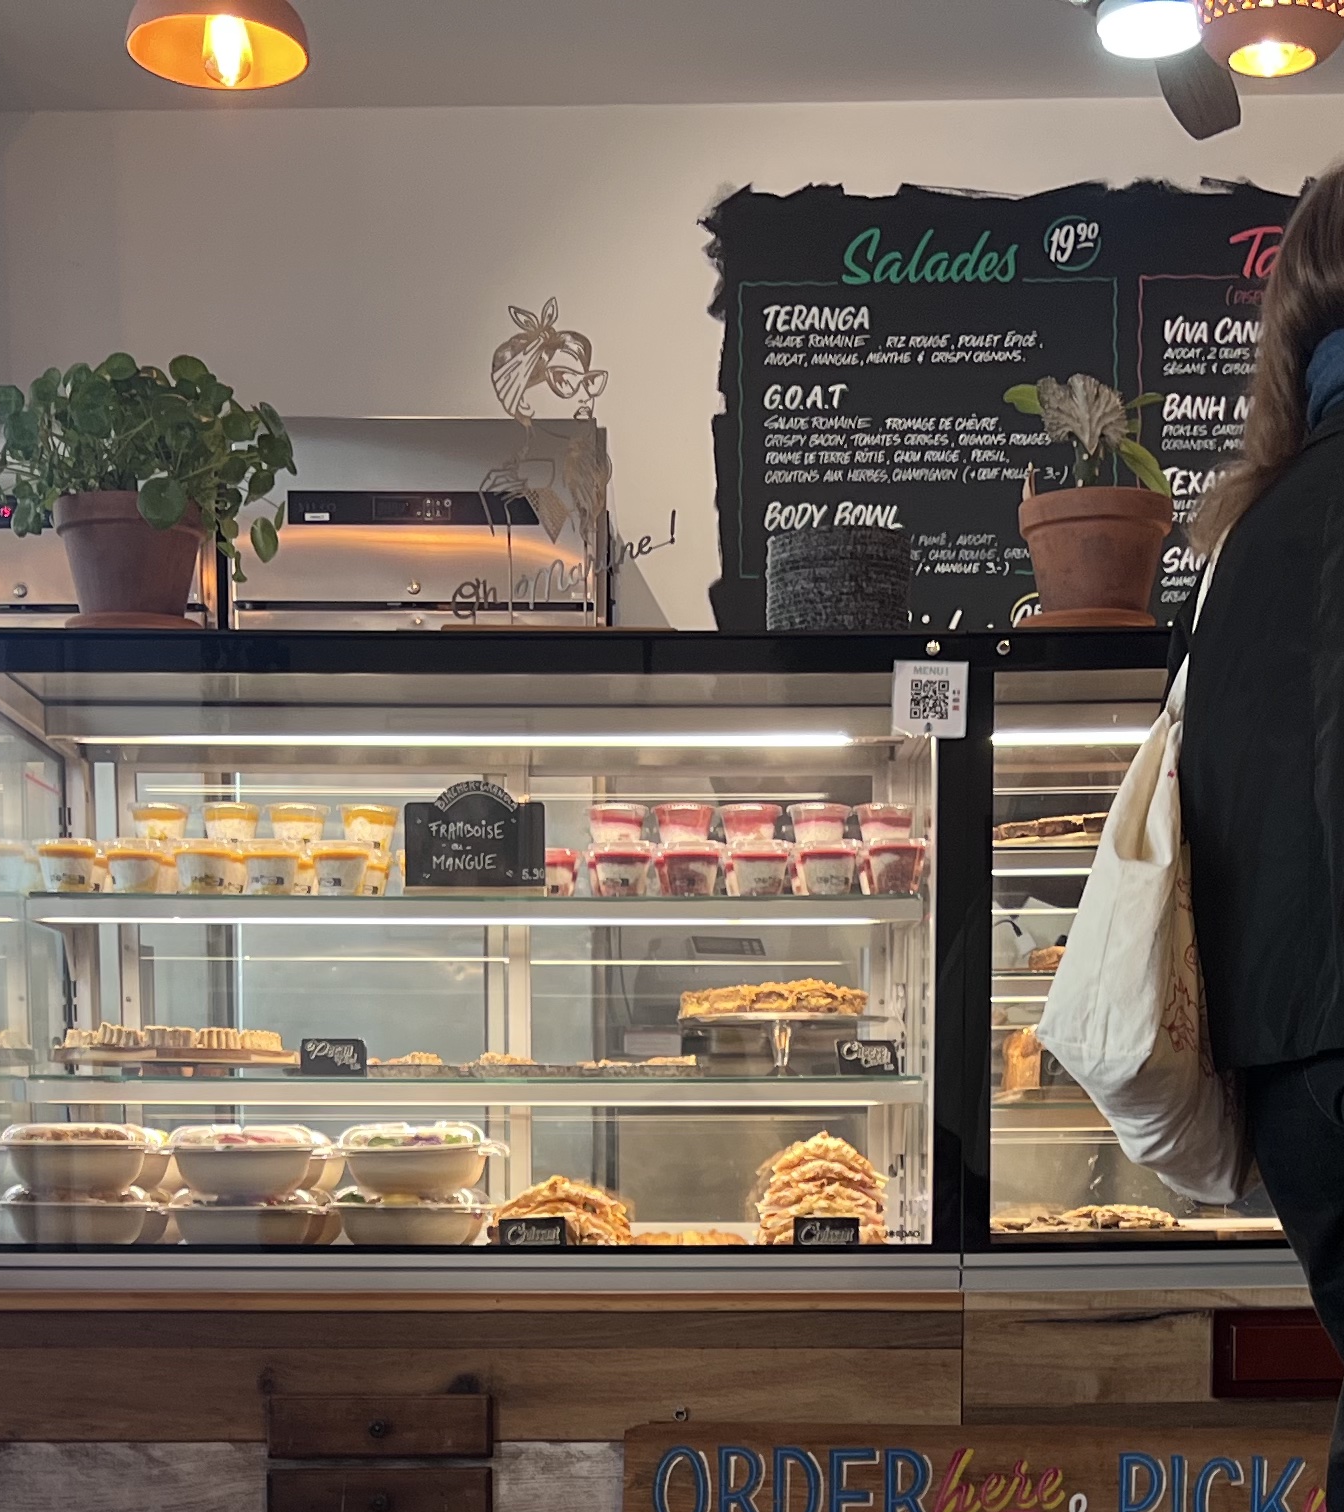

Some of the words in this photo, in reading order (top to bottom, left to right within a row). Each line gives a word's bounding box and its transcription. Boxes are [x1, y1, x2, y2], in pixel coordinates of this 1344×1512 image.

[842, 227, 1019, 285] Salades
[763, 304, 870, 332] TERANGA
[764, 334, 805, 349] SALADE
[886, 335, 907, 348] RIZ
[957, 334, 1002, 348] POULET
[763, 383, 849, 411] G.O.A.T
[1162, 392, 1226, 422] BANH
[763, 414, 809, 430] SALADE
[885, 416, 936, 431] FROMAGE
[938, 416, 954, 431] DE
[764, 433, 807, 447] CRISPY
[849, 433, 902, 447] TOMATES
[817, 450, 853, 465] TERRE
[763, 501, 827, 531] BODY
[428, 819, 505, 840] FRAMBOISE
[432, 852, 497, 871] MANGUE
